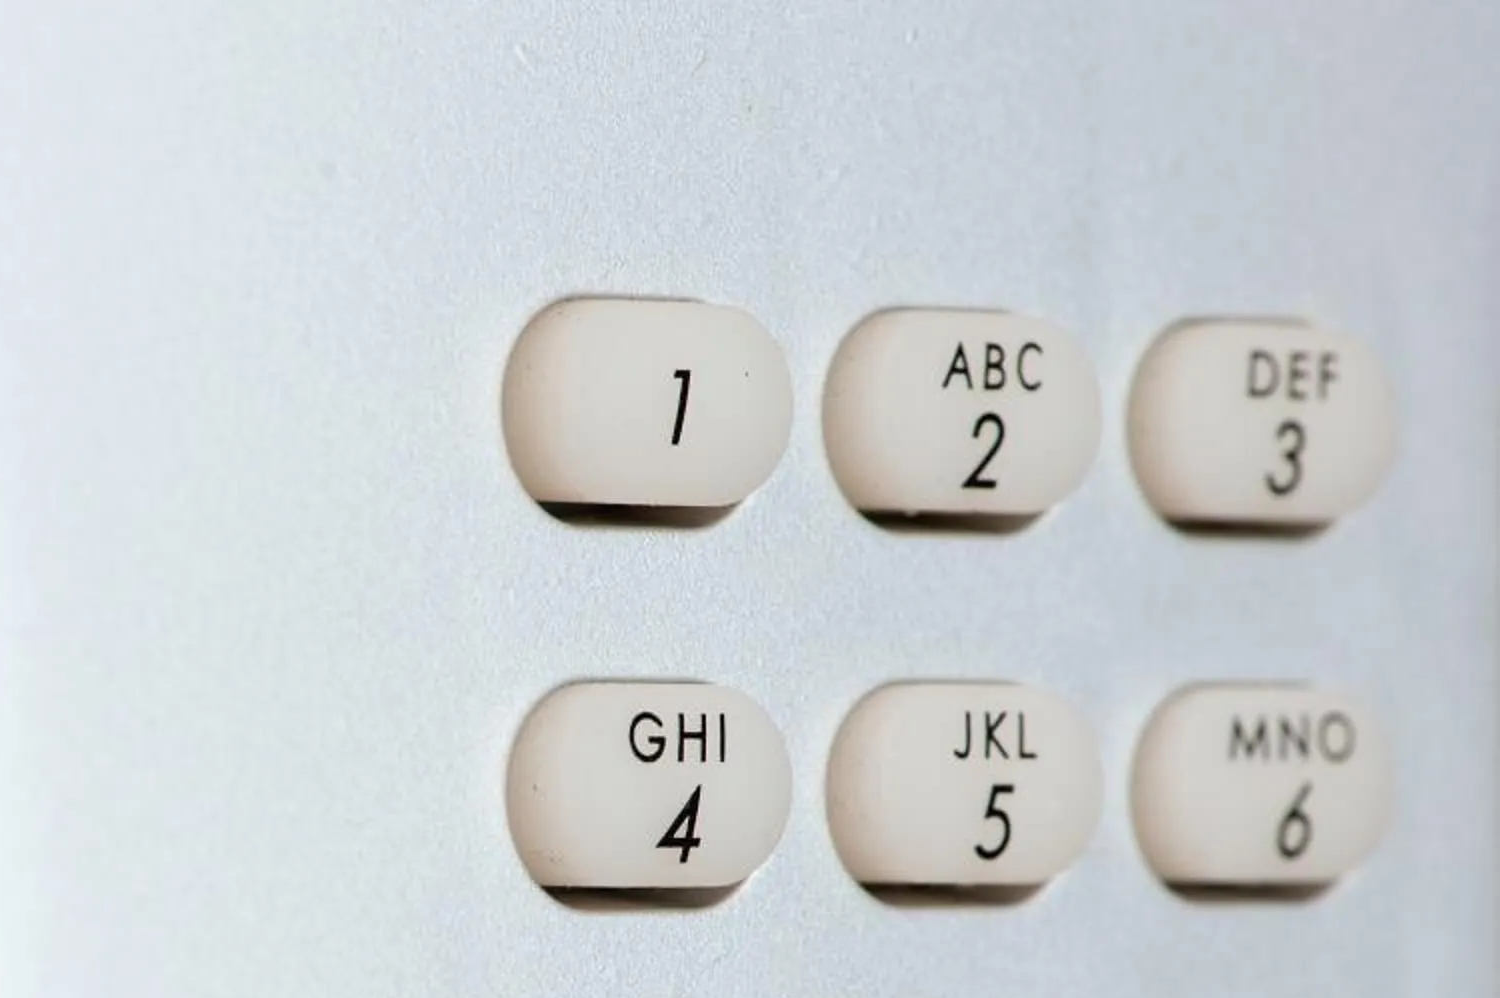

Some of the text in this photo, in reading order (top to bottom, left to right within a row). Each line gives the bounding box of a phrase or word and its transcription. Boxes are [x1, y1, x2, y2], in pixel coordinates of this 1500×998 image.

[940, 340, 1045, 393] ABC
[1244, 348, 1340, 402] DEF
[668, 367, 693, 447] 1
[958, 410, 1008, 491] 2
[1263, 419, 1308, 500] 3
[627, 710, 728, 765] GHI
[952, 710, 1040, 762] JKL
[1227, 711, 1357, 765] MNO
[654, 783, 703, 866] 4
[972, 782, 1016, 863] 5
[1273, 783, 1313, 863] 6
